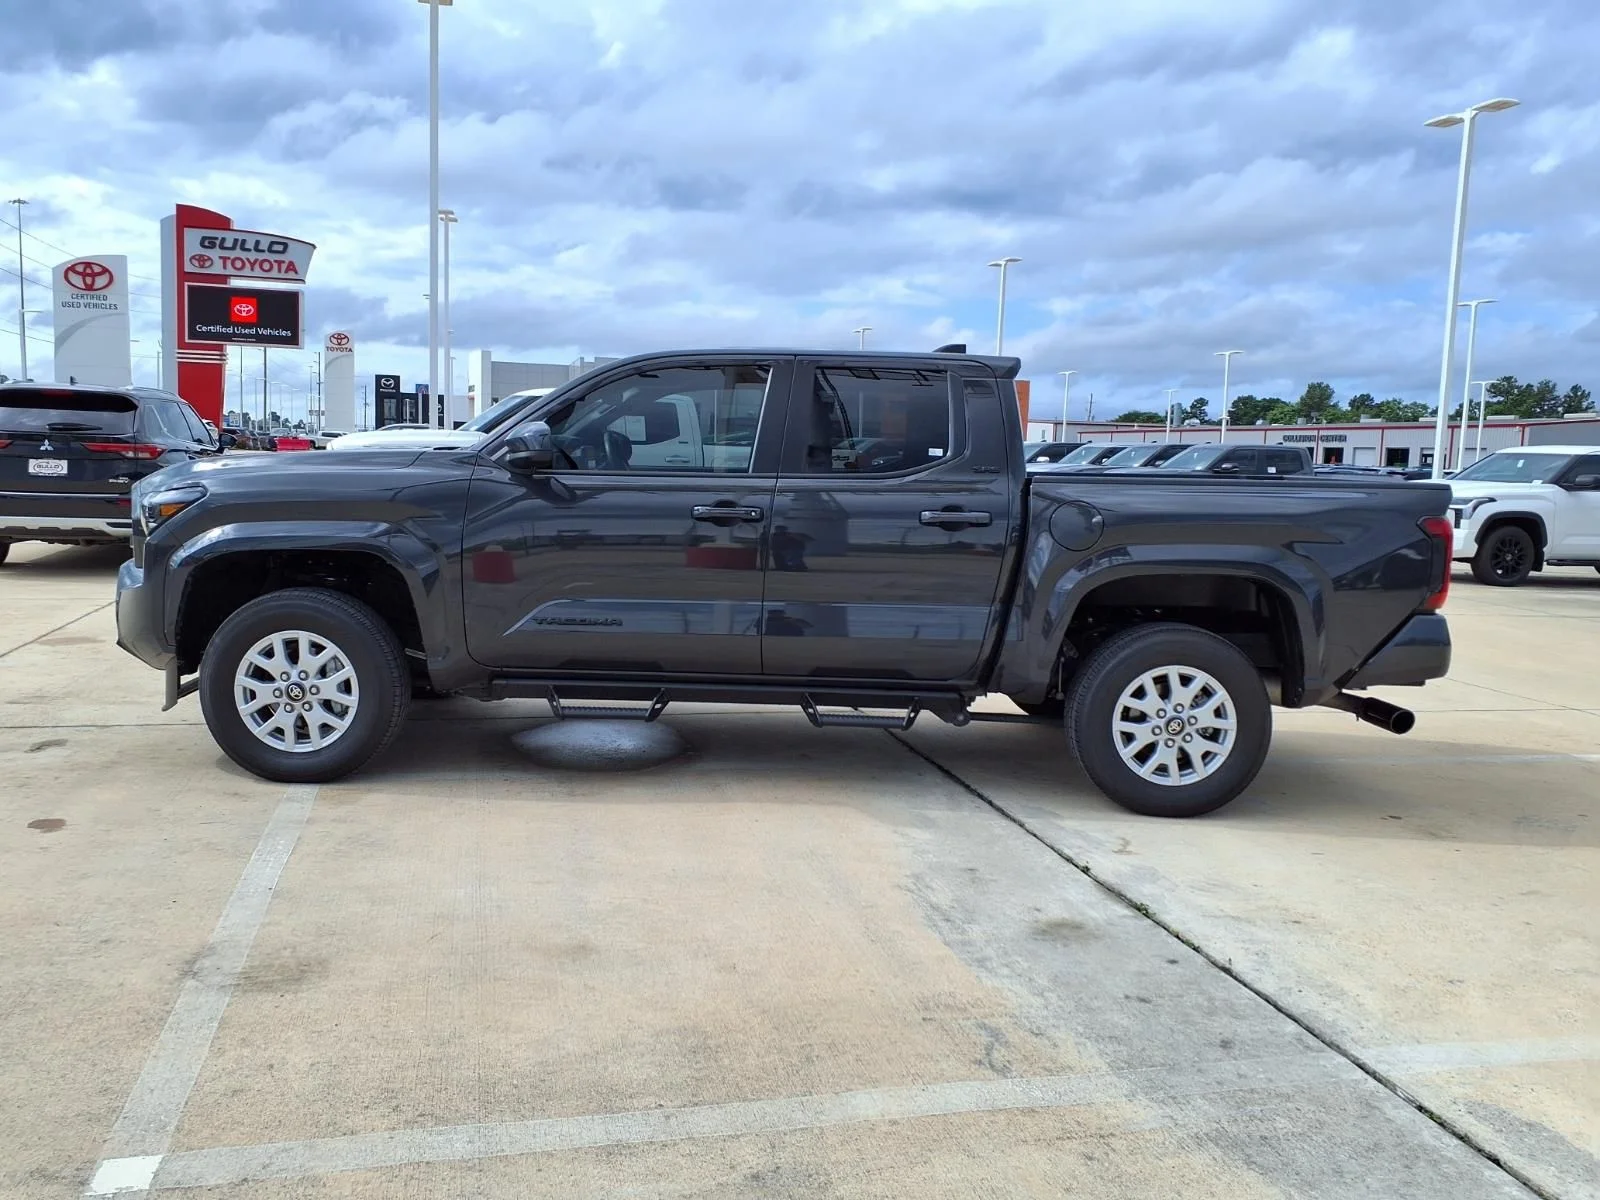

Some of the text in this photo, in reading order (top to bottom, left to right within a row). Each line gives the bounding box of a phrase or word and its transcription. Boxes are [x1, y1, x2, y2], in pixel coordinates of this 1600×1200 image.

[200, 235, 289, 254] GULLO
[218, 255, 299, 275] TOYOTA
[71, 293, 108, 301] CERTIFIED
[61, 301, 118, 310] USED VEHICLES
[195, 324, 292, 337] Certified Used Vehicles
